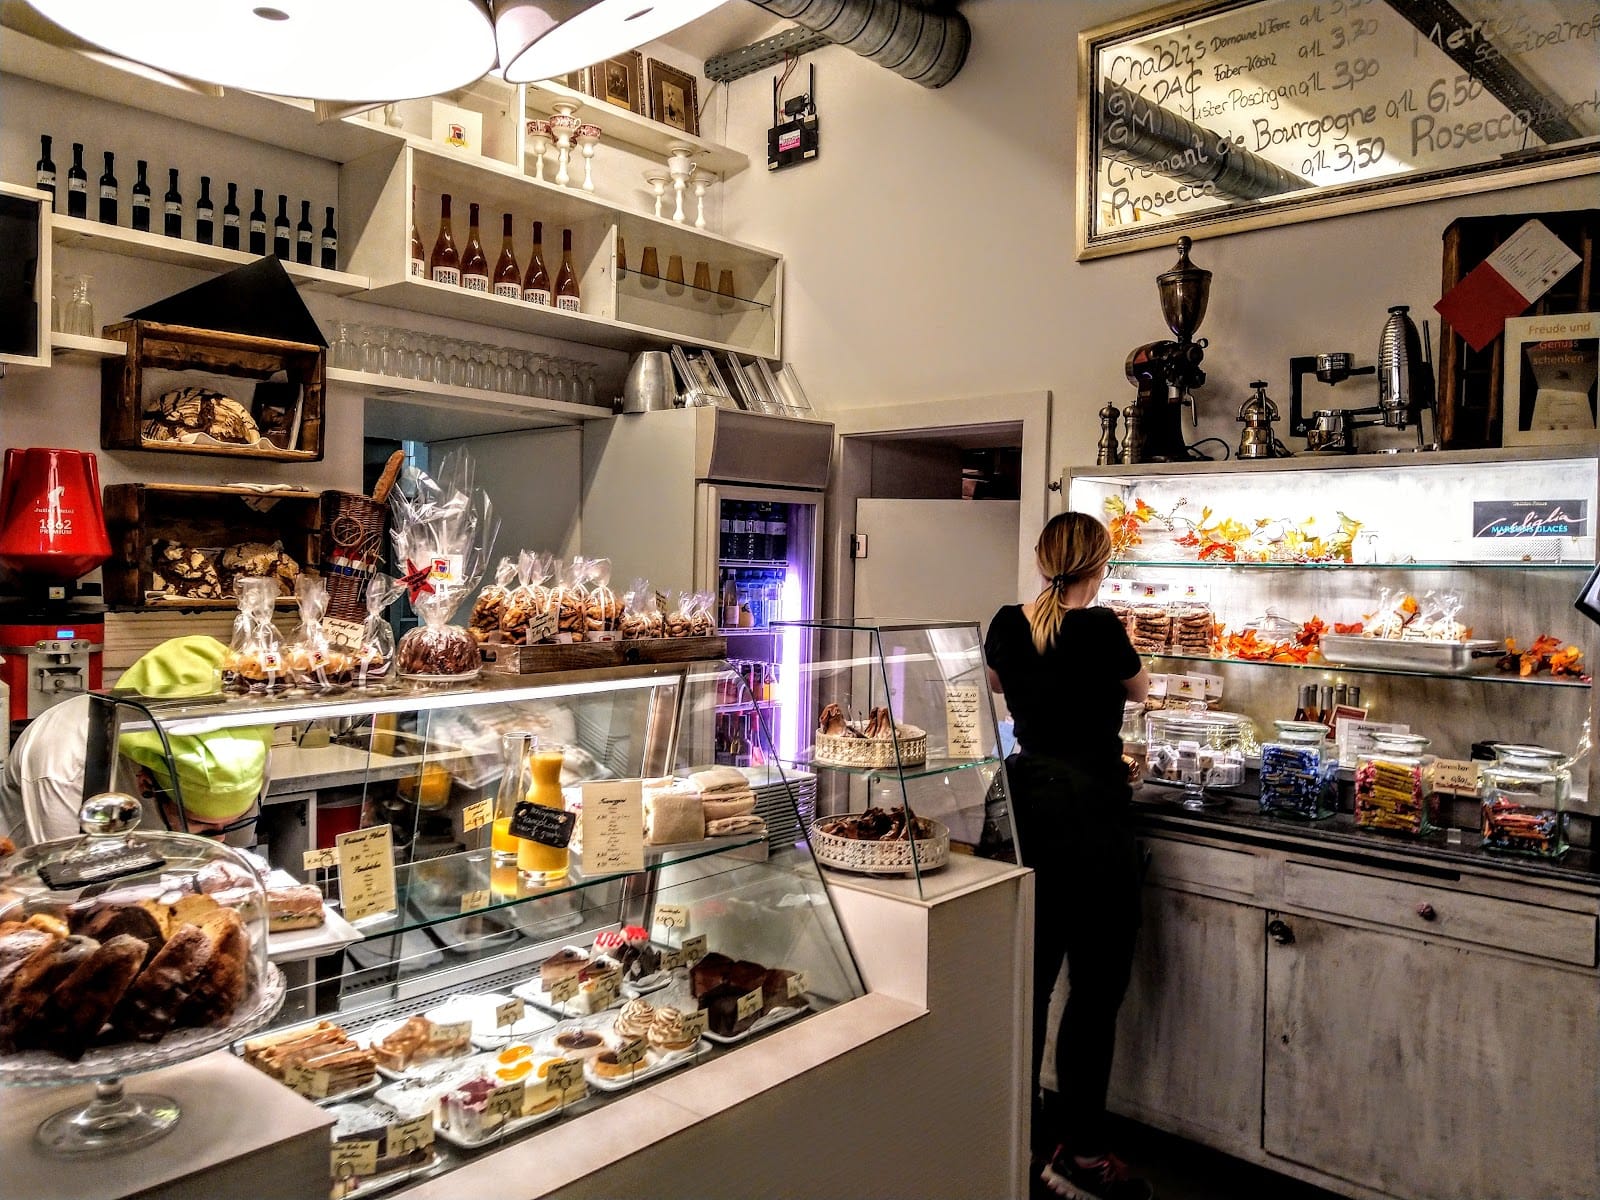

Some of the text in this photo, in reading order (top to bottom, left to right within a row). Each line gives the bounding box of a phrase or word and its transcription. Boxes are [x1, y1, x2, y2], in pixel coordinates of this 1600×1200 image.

[1110, 34, 1206, 90] Chablis
[1108, 110, 1155, 145] GM
[1331, 58, 1380, 91] 3,90
[1152, 69, 1203, 105] DAC
[1252, 105, 1377, 153] Bourgogne
[1385, 88, 1418, 119] 0,1L
[1427, 75, 1484, 113] 6,50
[1111, 136, 1386, 219] Prosecco 0,1L 3,50
[1528, 321, 1591, 335] Freude und
[39, 519, 72, 530] 1862
[1537, 523, 1568, 533] GLACÉS
